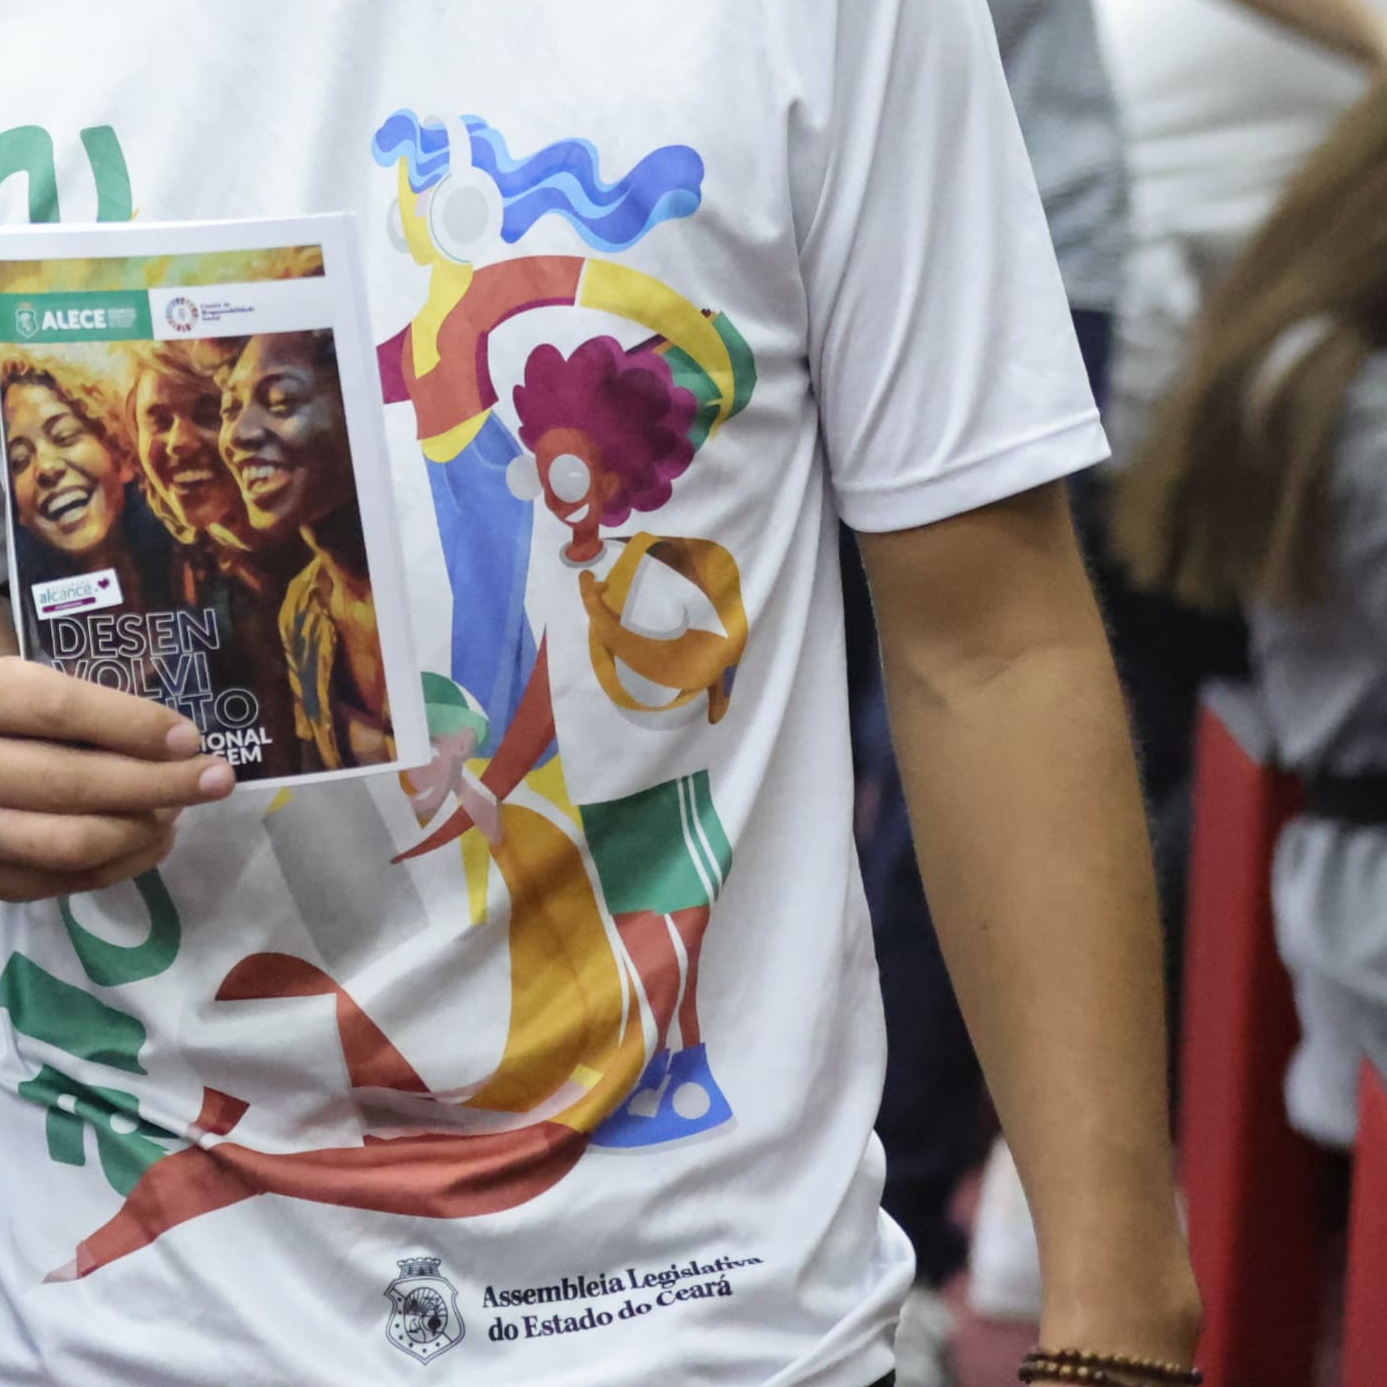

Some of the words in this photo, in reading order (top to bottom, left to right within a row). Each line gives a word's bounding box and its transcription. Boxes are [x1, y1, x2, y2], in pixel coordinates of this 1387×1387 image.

[41, 309, 107, 331] ALECE
[50, 608, 220, 661] DESEN
[482, 1276, 625, 1309] Assembleia
[628, 1254, 765, 1290] Legislativa
[487, 1316, 519, 1343] do
[521, 1308, 614, 1339] Estado
[618, 1300, 653, 1321] do
[655, 1273, 734, 1309] Ceará
